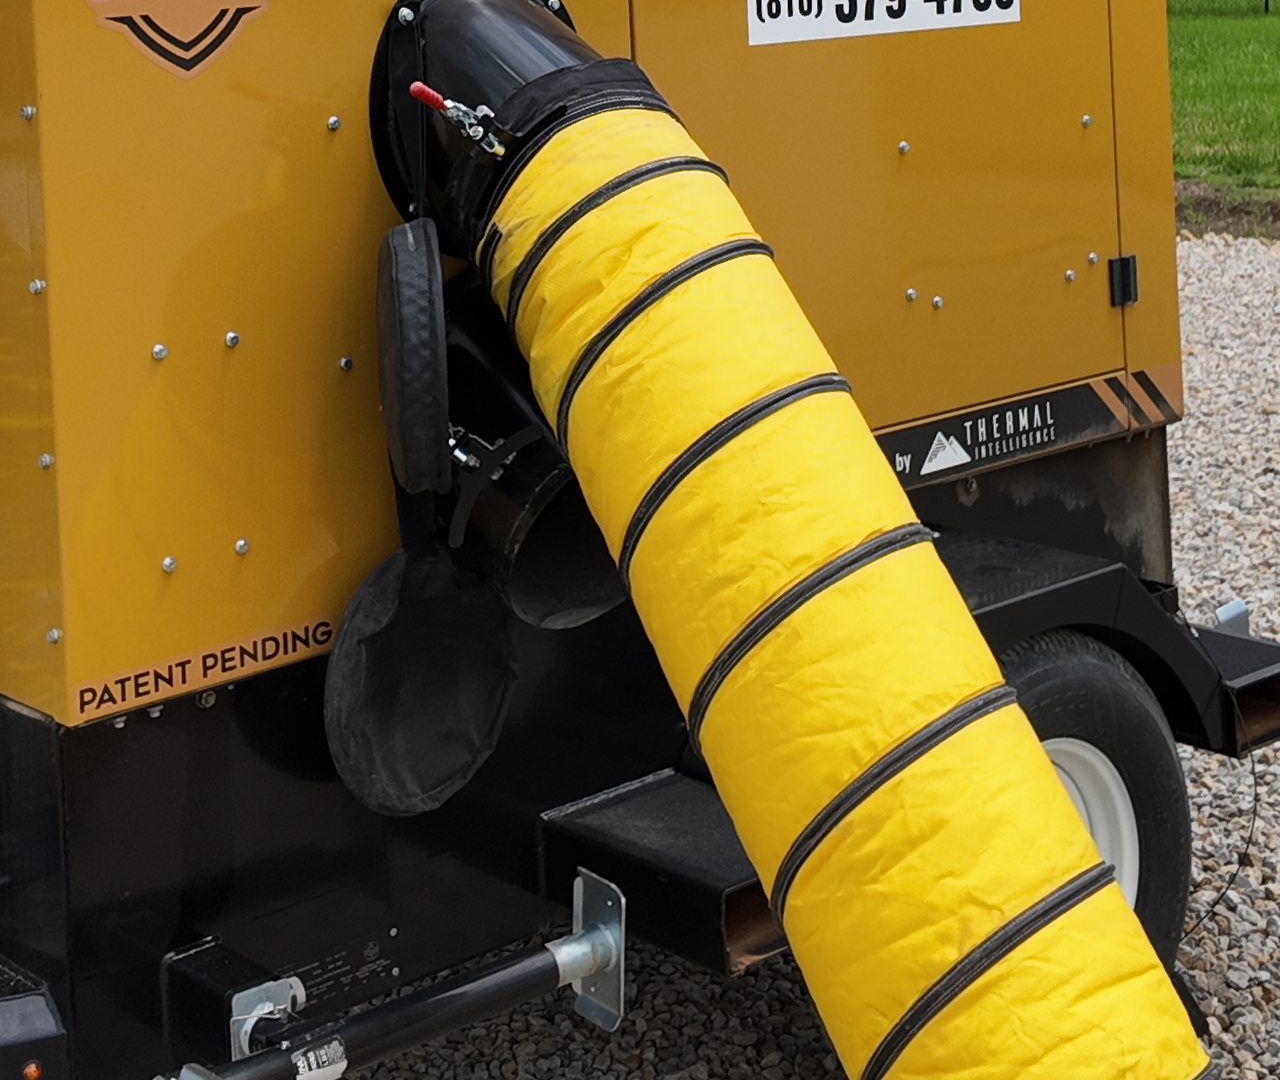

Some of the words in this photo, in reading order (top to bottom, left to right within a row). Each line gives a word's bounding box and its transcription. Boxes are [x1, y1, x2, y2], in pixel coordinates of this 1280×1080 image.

[963, 401, 1054, 446] THERMAL
[974, 426, 1056, 461] INTELLIGENCE
[895, 452, 912, 474] by
[79, 658, 192, 714] PATENT
[201, 621, 334, 679] PENDING
